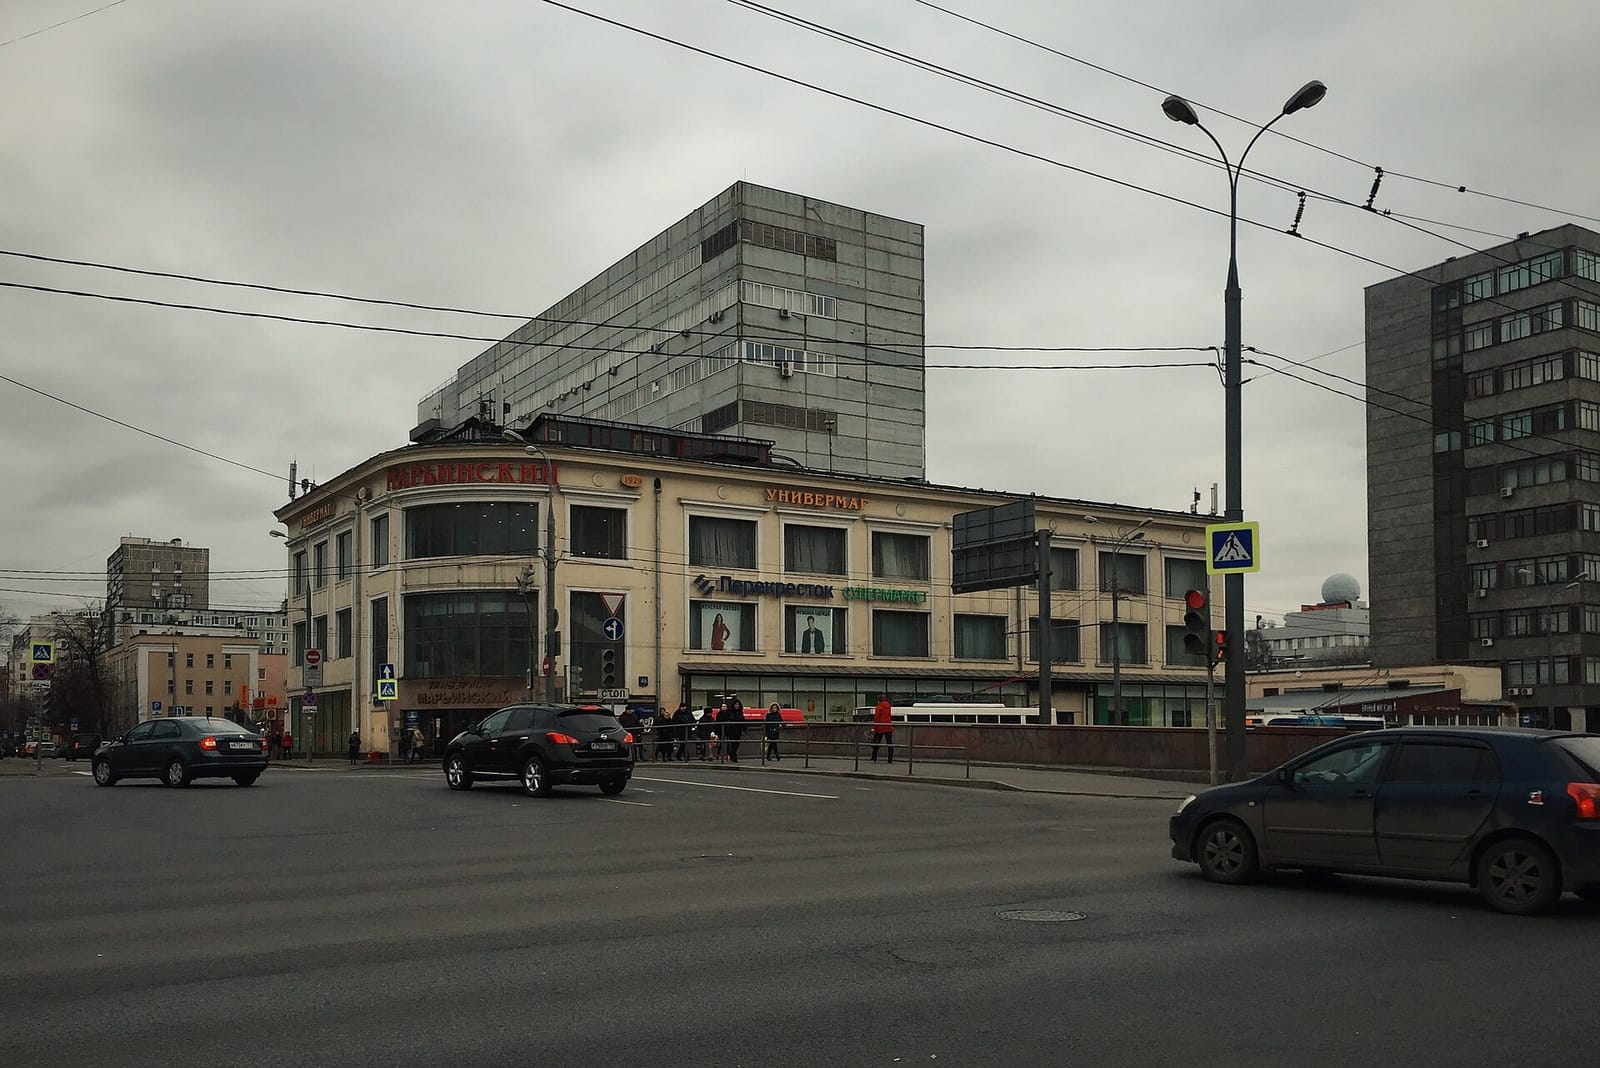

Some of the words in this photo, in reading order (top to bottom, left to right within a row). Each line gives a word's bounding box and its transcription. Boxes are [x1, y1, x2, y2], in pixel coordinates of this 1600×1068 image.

[623, 475, 642, 485] 1929
[766, 488, 868, 510] УНИВЕРМАГ
[720, 576, 834, 599] Перекресток
[843, 587, 928, 604] СУПЕРМАРКЕТ
[601, 690, 625, 698] СТОП
